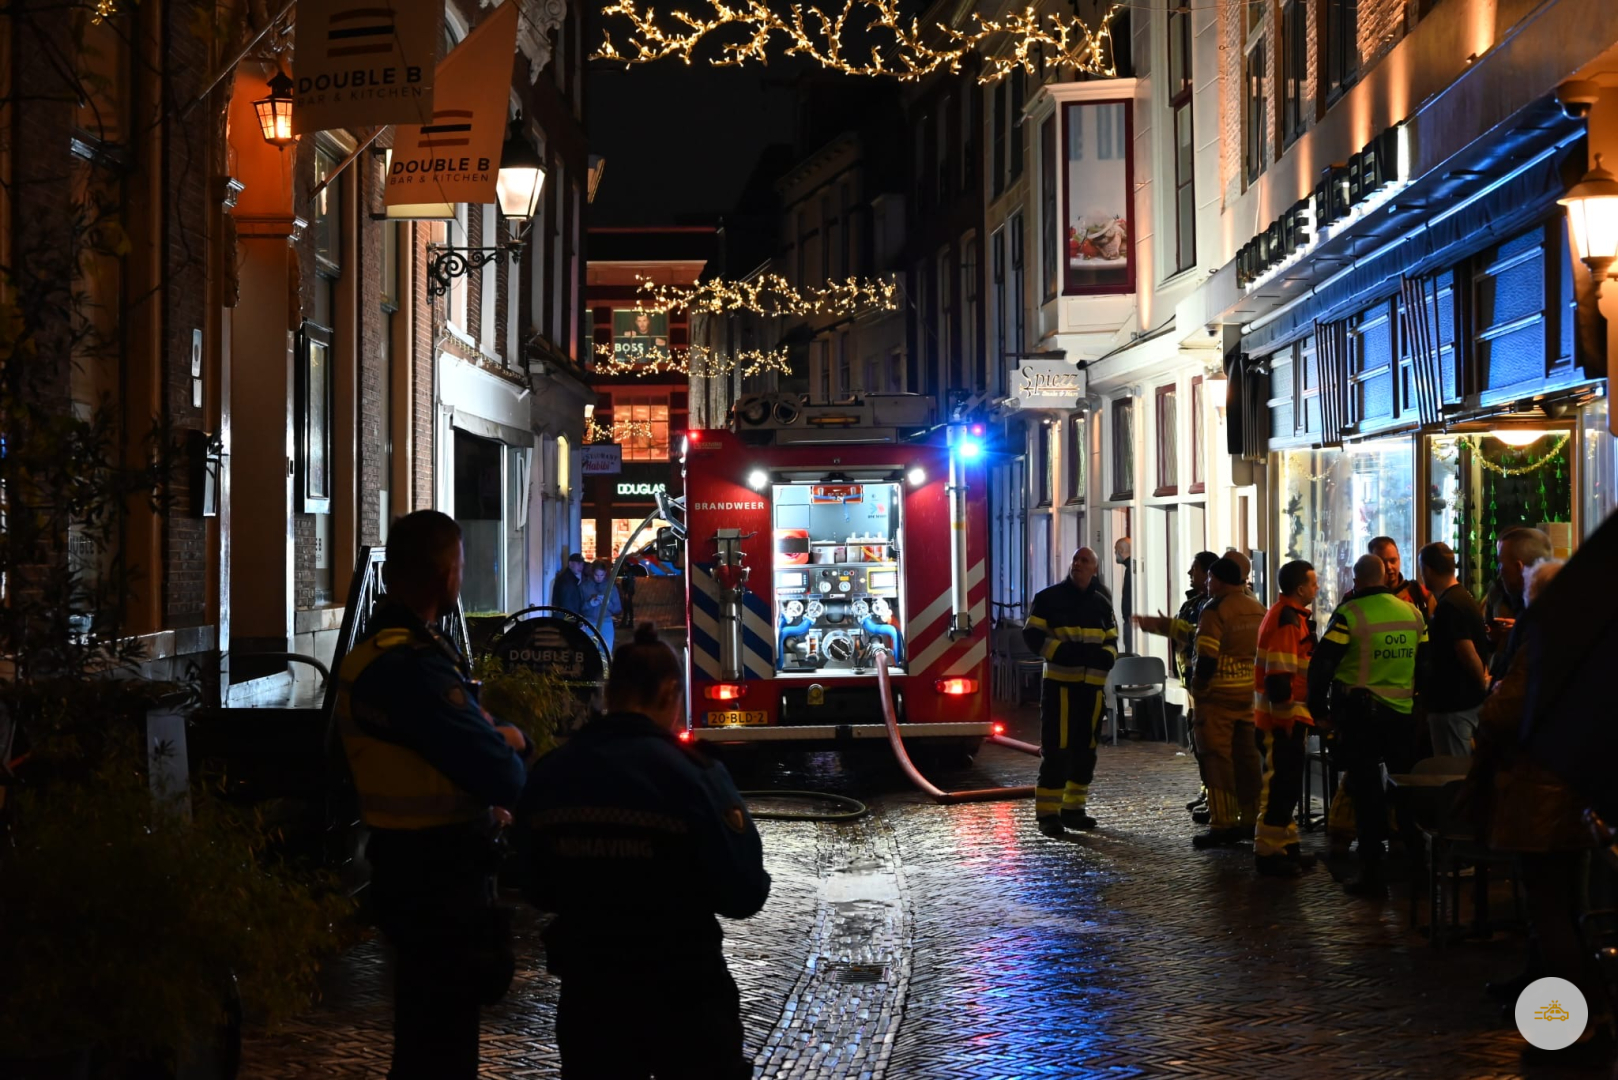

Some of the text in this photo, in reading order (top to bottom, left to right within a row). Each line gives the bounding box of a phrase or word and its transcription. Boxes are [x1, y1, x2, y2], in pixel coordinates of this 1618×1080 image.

[299, 66, 422, 94] DOUBLE B
[351, 86, 422, 101] KITCHEN
[392, 157, 490, 175] DOUBLE B
[390, 173, 489, 186] BAR & KITCHEN
[614, 343, 644, 353] BOSS
[617, 483, 666, 495] DOUGLAS
[694, 501, 765, 511] BRANDWEER
[1385, 634, 1406, 645] OvD
[509, 649, 585, 663] DOUBLE B
[1374, 648, 1413, 659] POLITIE
[710, 712, 764, 724] 20-BLD-2
